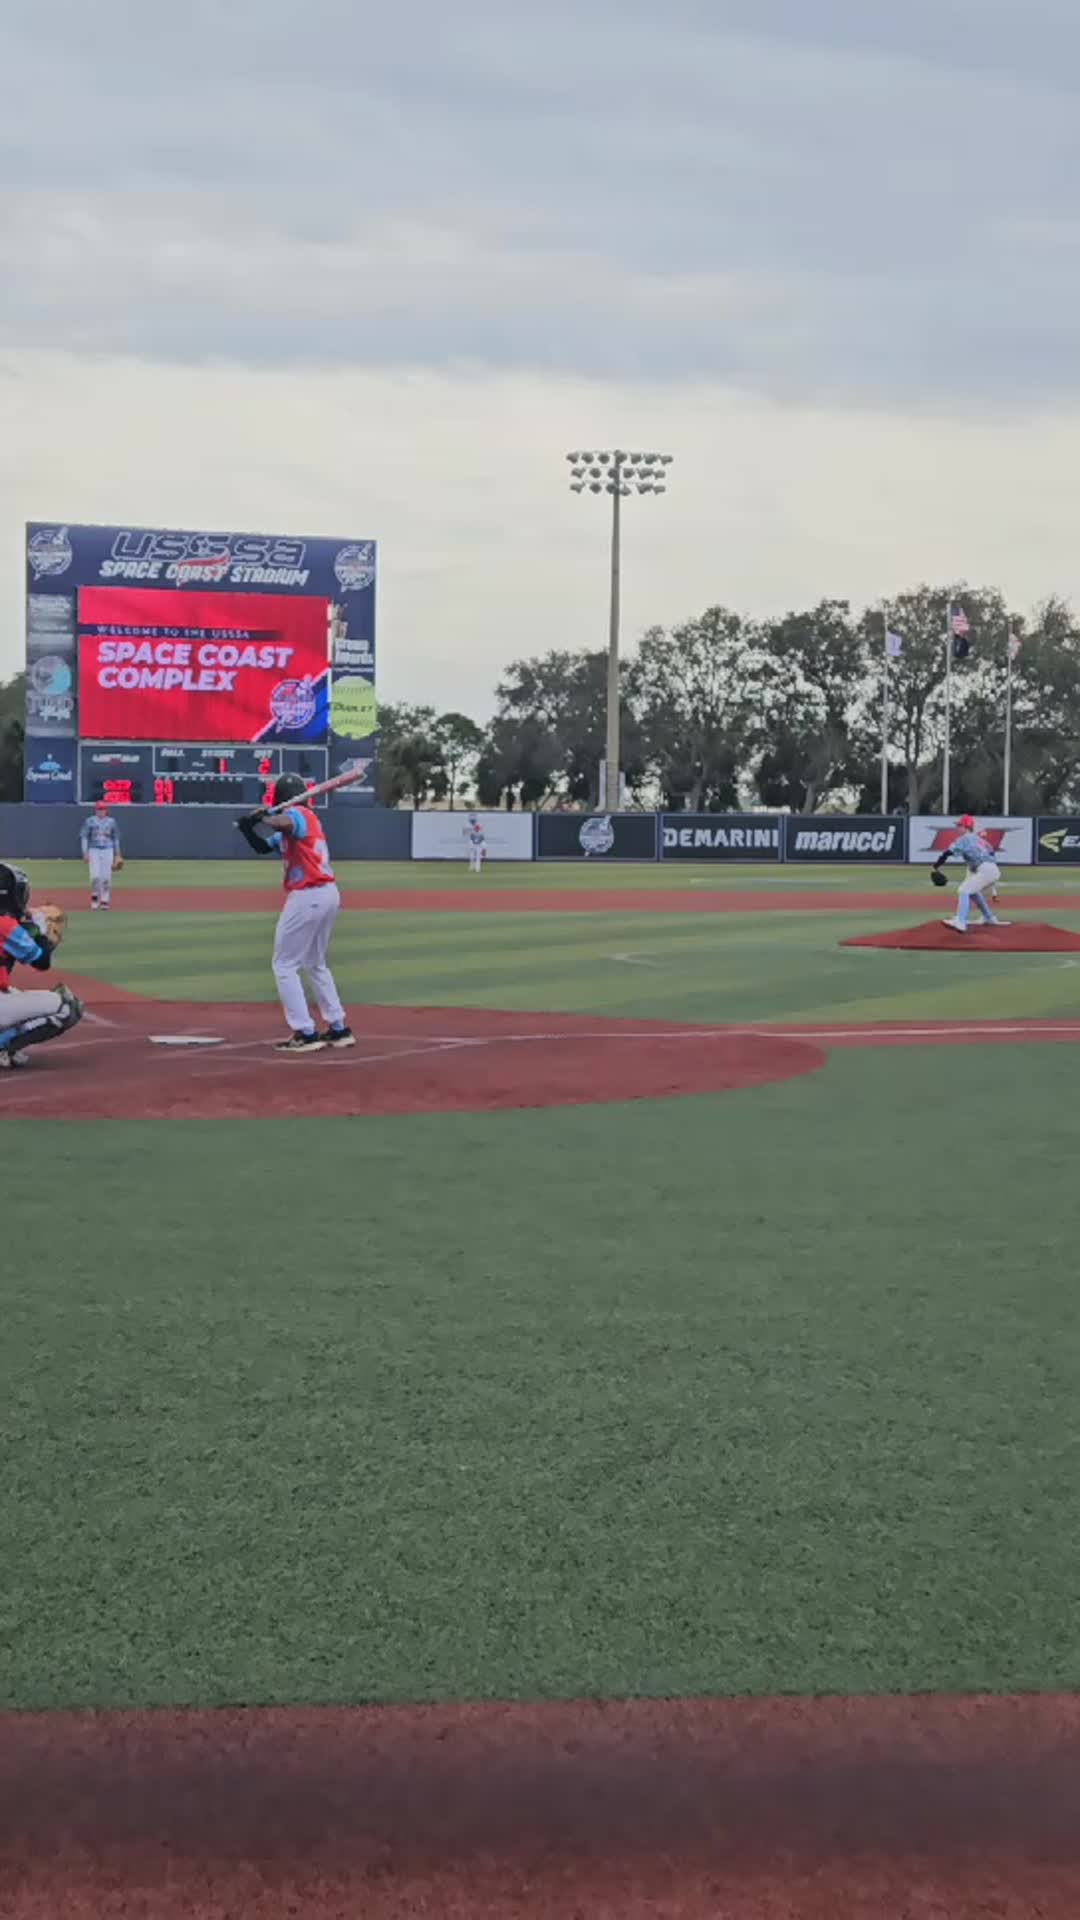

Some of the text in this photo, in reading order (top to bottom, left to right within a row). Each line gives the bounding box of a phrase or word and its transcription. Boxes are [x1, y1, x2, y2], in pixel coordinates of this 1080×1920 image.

[99, 559, 162, 579] SPACE
[166, 562, 229, 582] COAST
[230, 564, 310, 586] STADIUM
[97, 625, 250, 640] WELCOME TO THE USSSA
[97, 641, 293, 669] SPACE COAST
[97, 666, 237, 691] COMPLEX
[663, 828, 779, 848] DEMARINI
[794, 825, 897, 854] marucci
